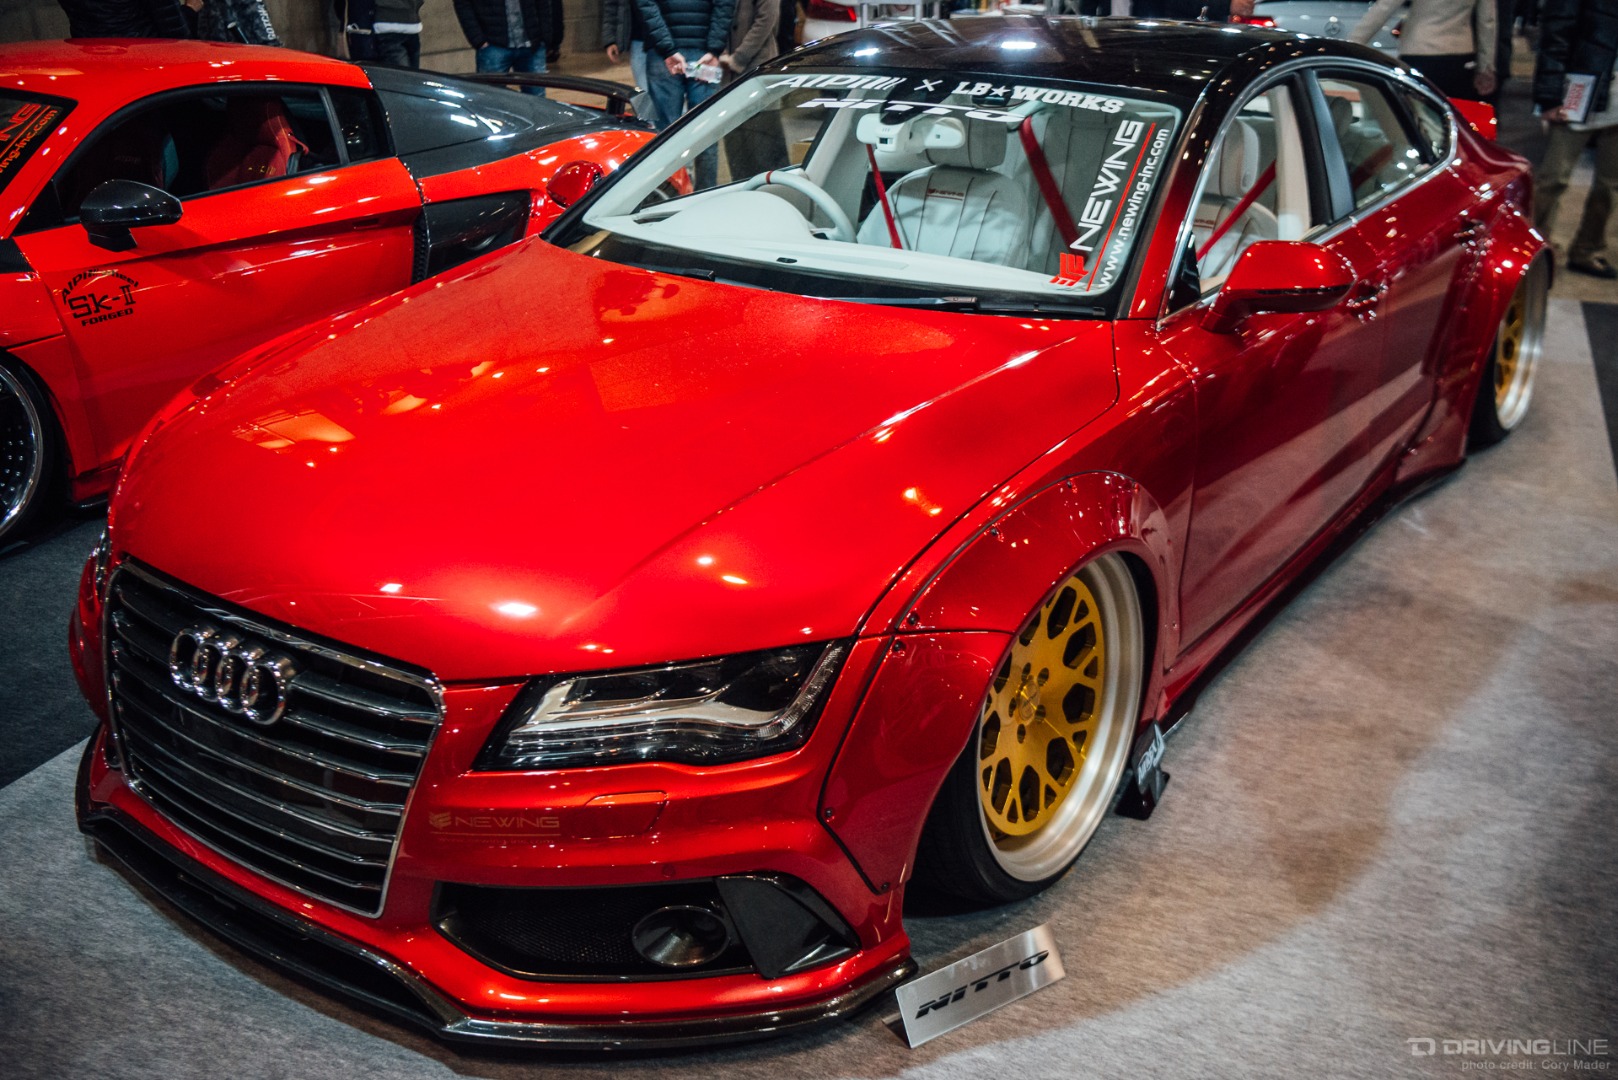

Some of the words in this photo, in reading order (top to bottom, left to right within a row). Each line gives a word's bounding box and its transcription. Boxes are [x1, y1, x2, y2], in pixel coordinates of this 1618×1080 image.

[1070, 120, 1144, 252] NEWING
[1101, 128, 1170, 288] www.newing-inc.com
[82, 308, 133, 326] FORGED
[455, 816, 560, 828] NEWING
